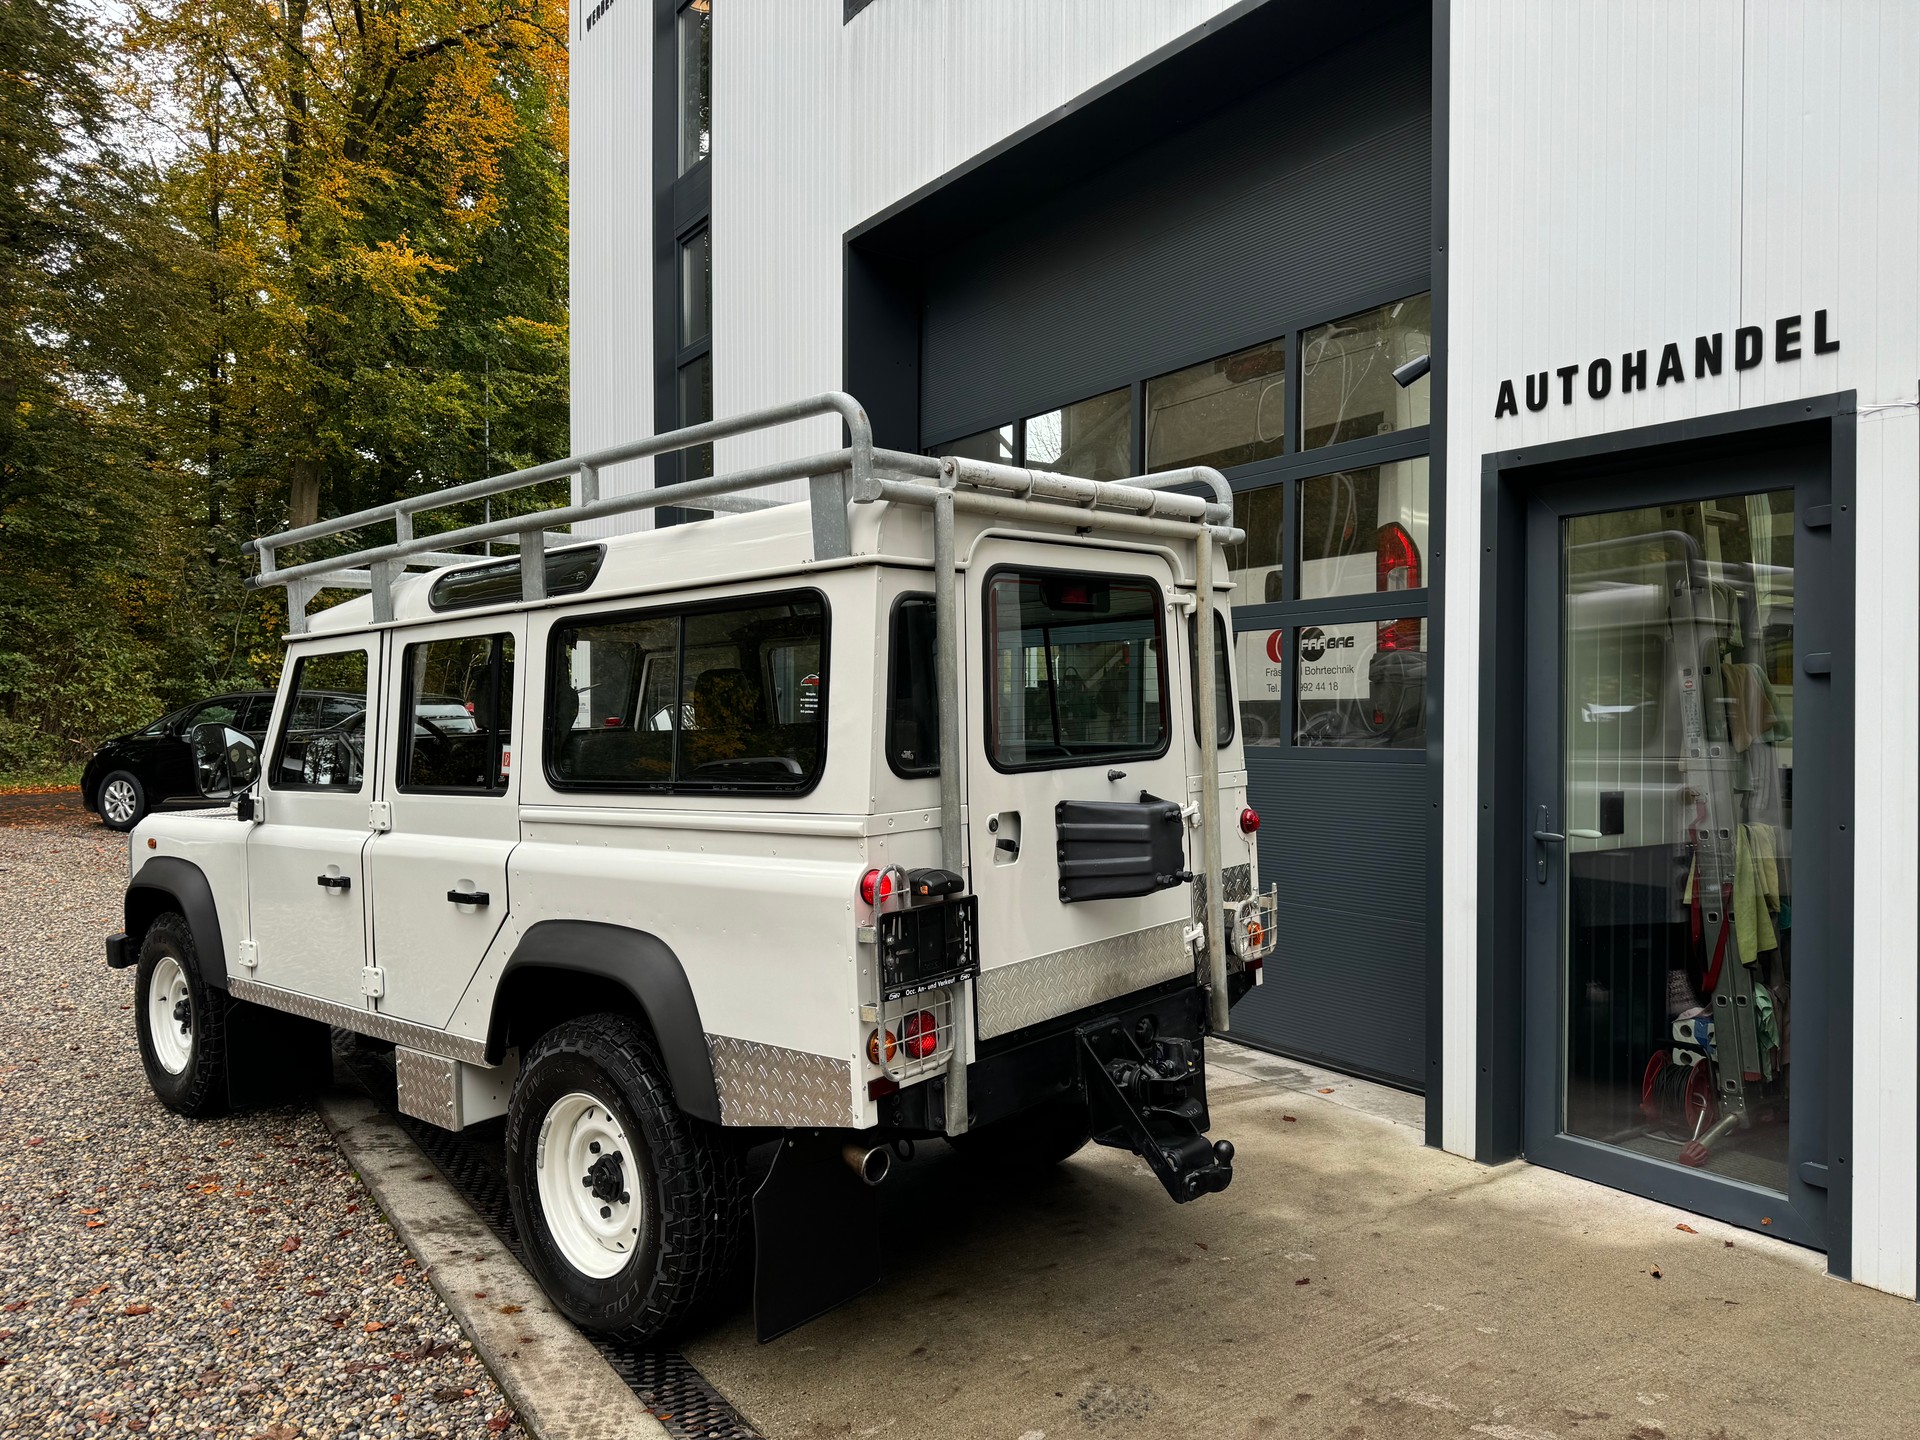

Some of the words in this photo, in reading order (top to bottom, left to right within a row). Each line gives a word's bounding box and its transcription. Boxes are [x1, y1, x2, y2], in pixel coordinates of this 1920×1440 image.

[1495, 309, 1840, 418] AUTOHANDEL
[1304, 665, 1355, 676] Bohrtechnik
[1267, 683, 1280, 692] Tel.
[1315, 682, 1326, 691] 44
[1328, 681, 1339, 691] 18
